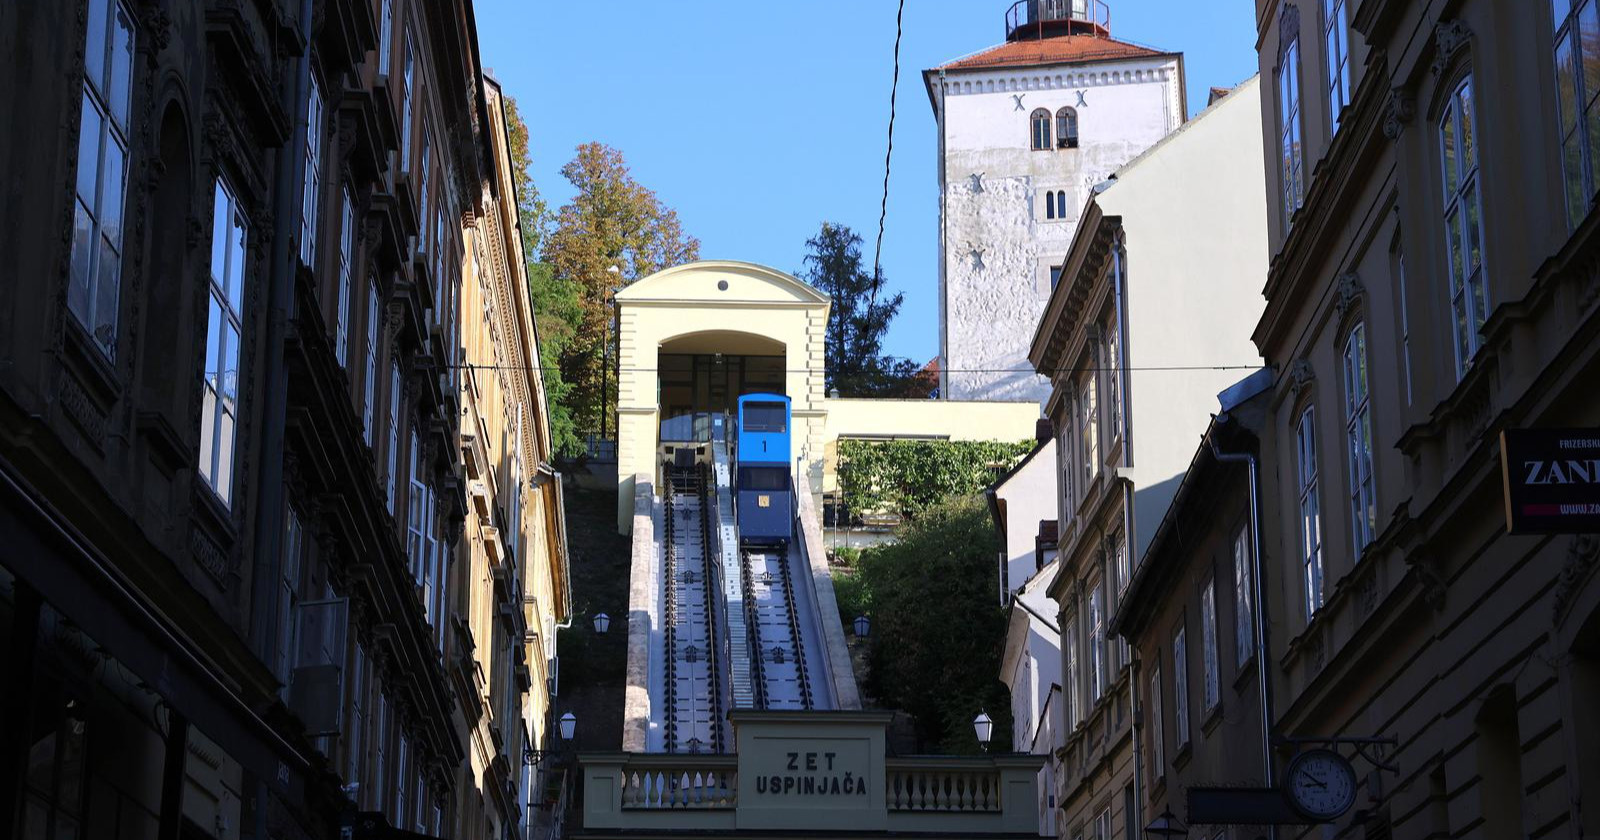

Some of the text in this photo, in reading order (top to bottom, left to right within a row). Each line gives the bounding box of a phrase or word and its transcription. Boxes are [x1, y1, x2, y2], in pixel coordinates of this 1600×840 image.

[762, 440, 767, 453] 1
[787, 752, 836, 771] ZET
[757, 771, 866, 795] USPINJAČA
